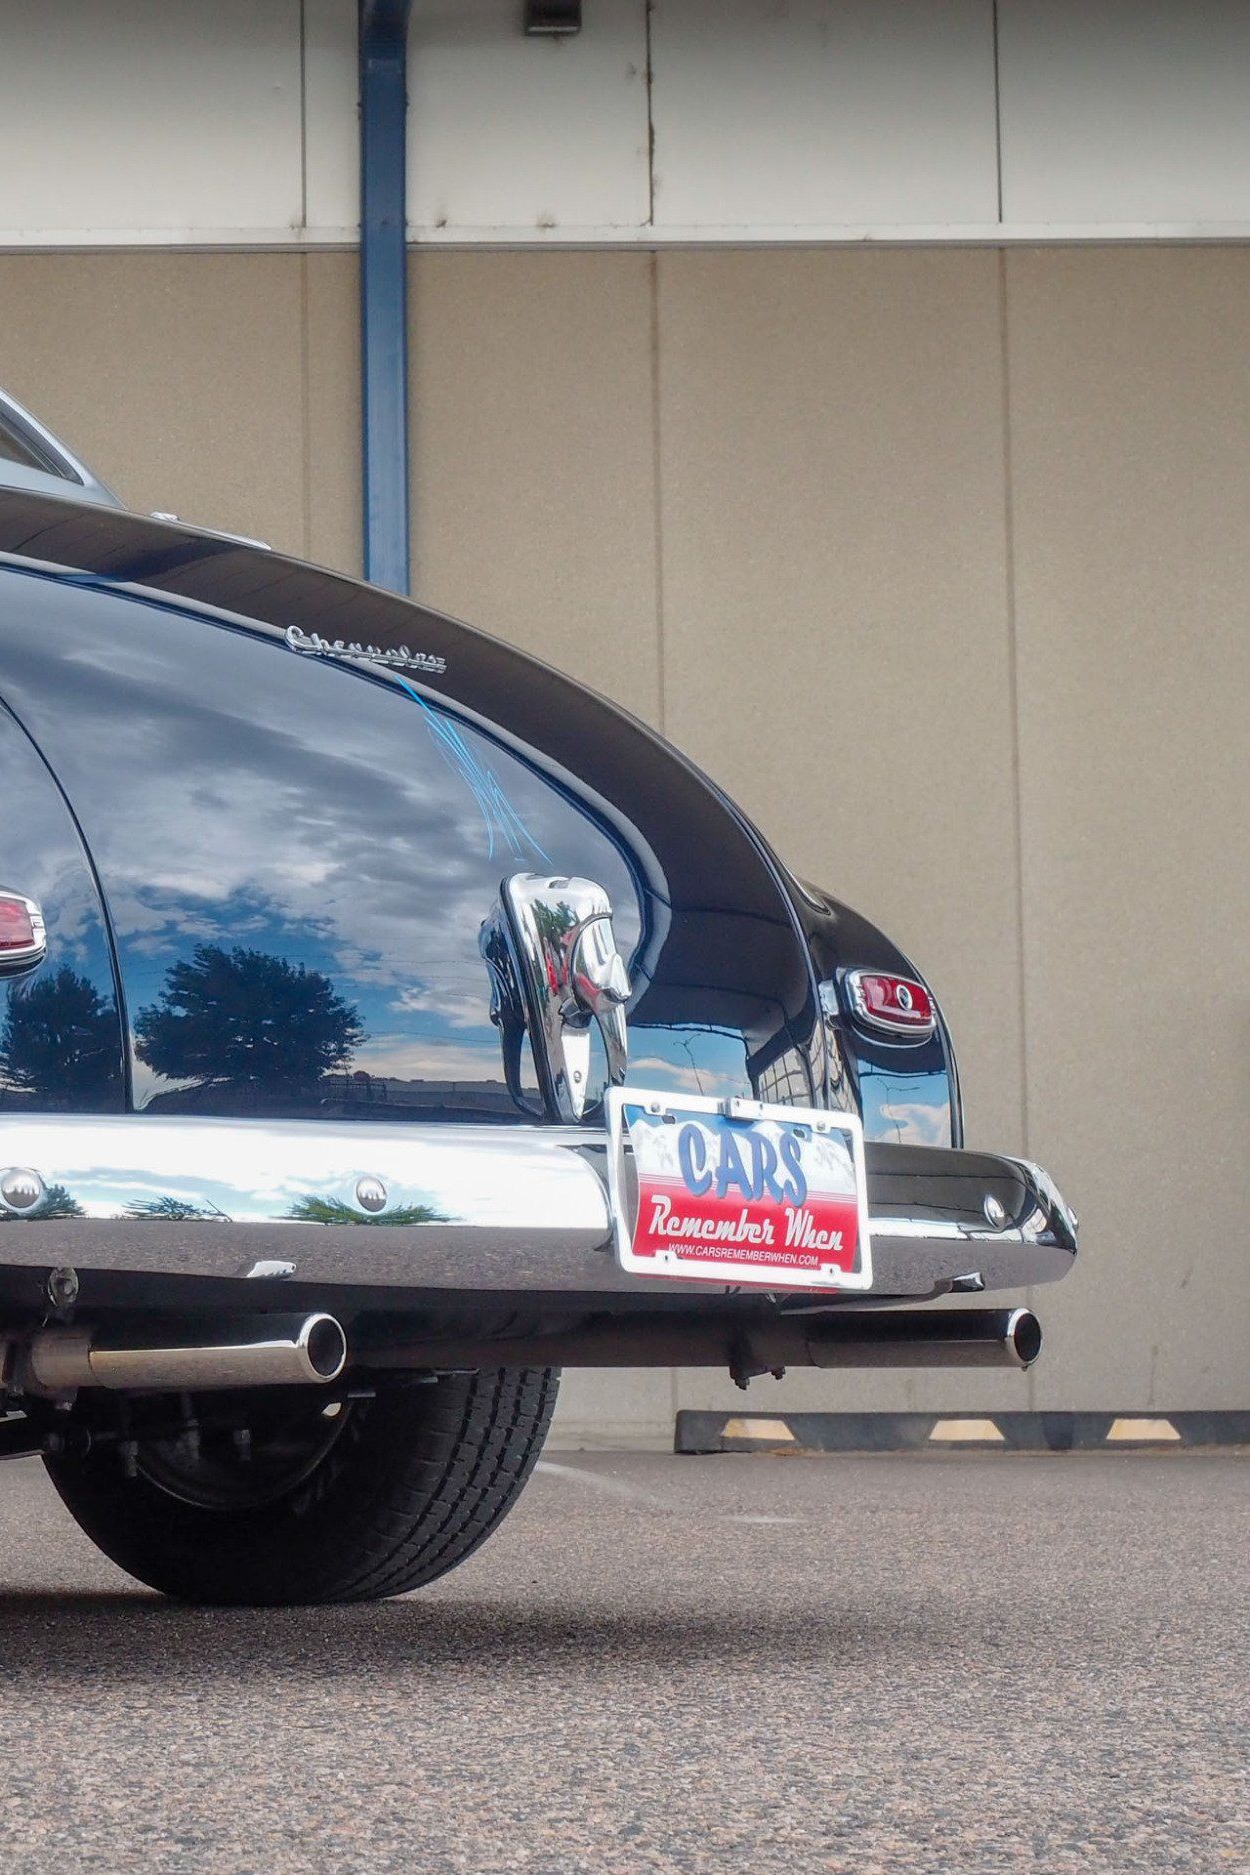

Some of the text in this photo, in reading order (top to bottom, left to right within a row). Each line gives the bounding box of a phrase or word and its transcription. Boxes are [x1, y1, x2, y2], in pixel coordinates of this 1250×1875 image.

[678, 1124, 807, 1207] CARS
[648, 1194, 843, 1251] Remember When
[668, 1242, 818, 1266] WWW.CARSREMEMBERWHEN.COM
